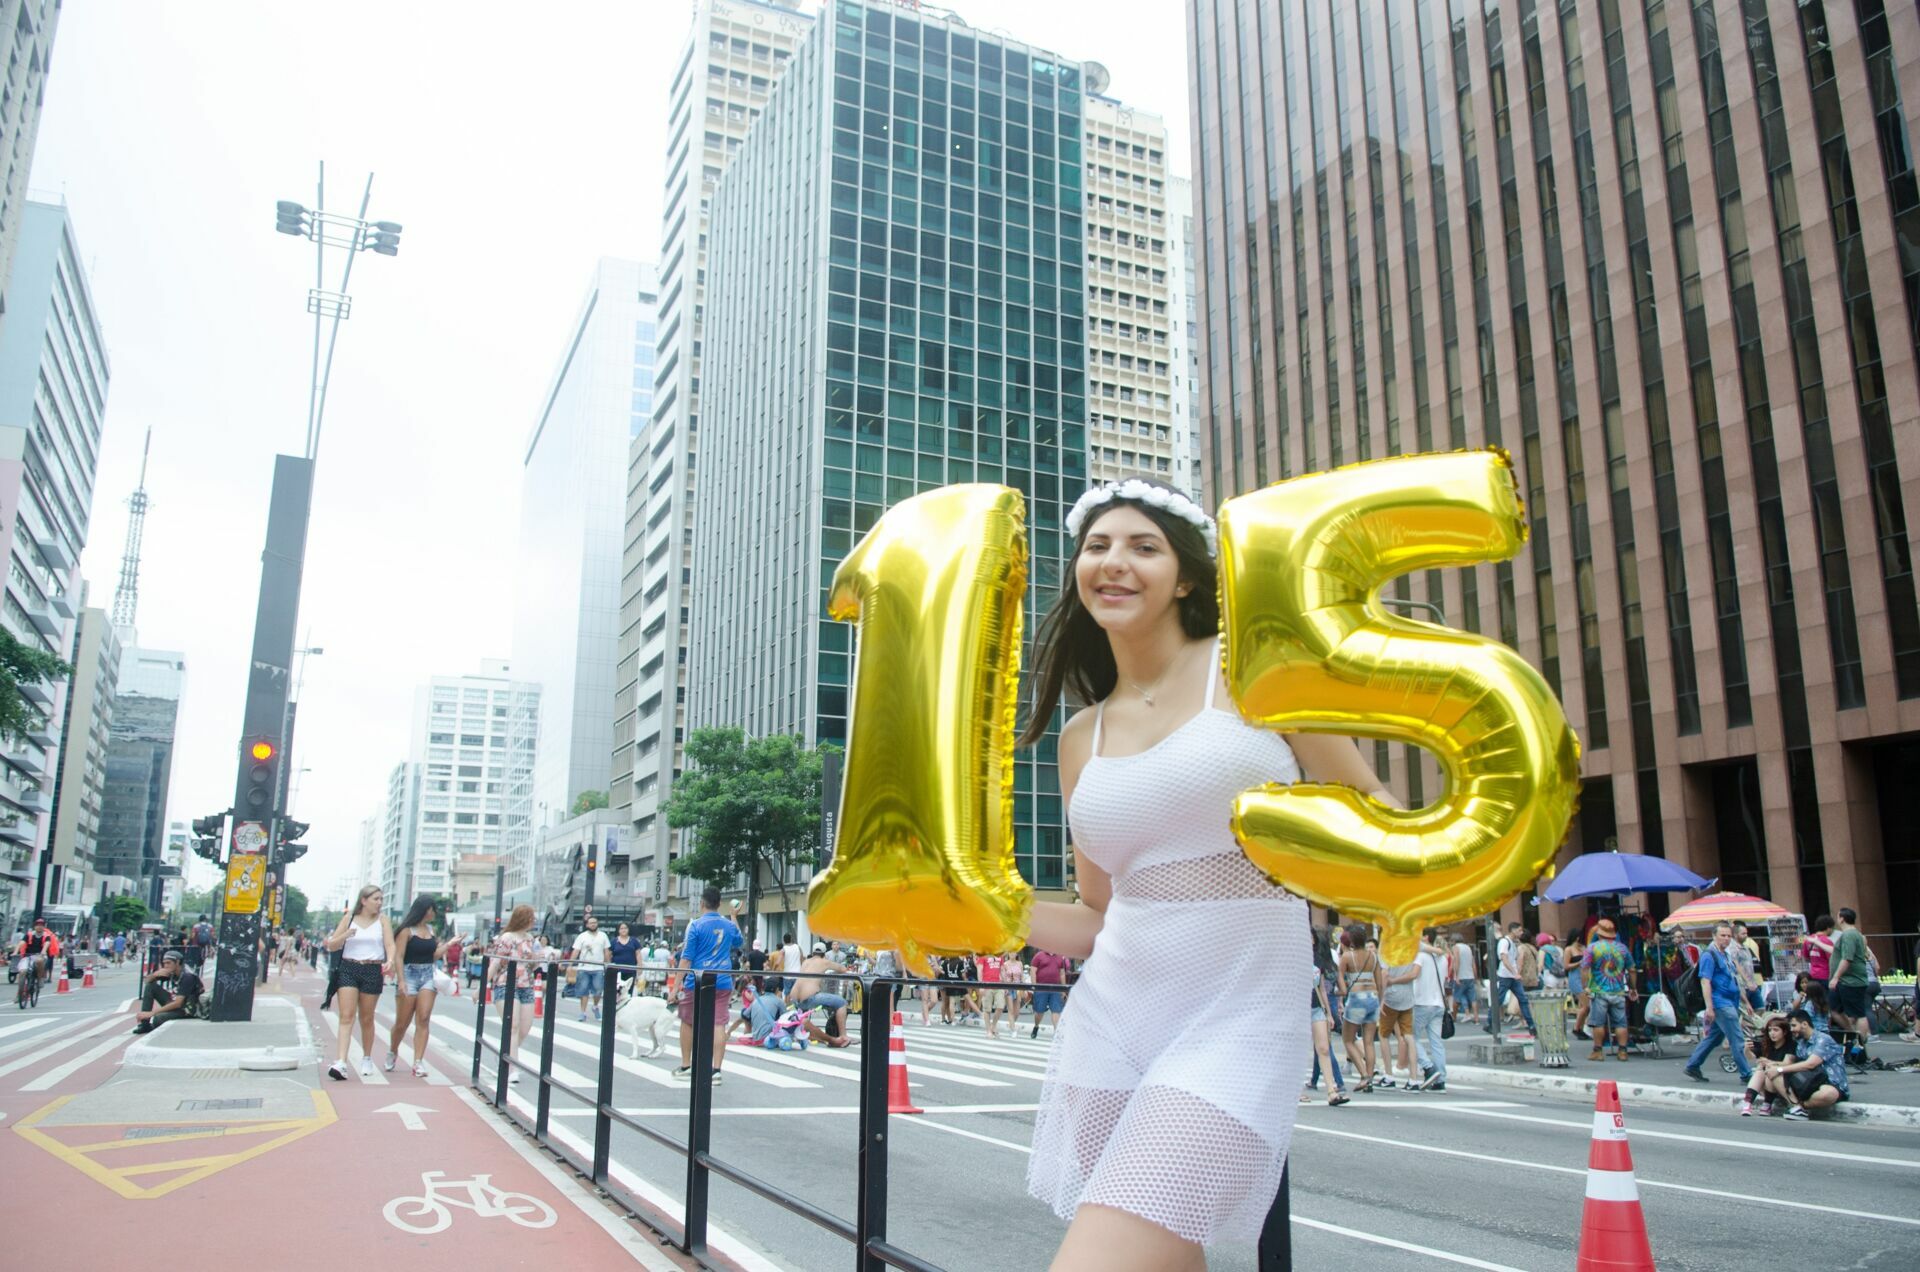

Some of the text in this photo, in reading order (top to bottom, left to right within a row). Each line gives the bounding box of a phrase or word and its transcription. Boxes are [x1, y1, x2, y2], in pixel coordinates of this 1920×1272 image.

[808, 483, 1033, 957] 1
[1217, 446, 1582, 930] 5
[713, 928, 724, 956] 7
[824, 811, 834, 852] Augusta
